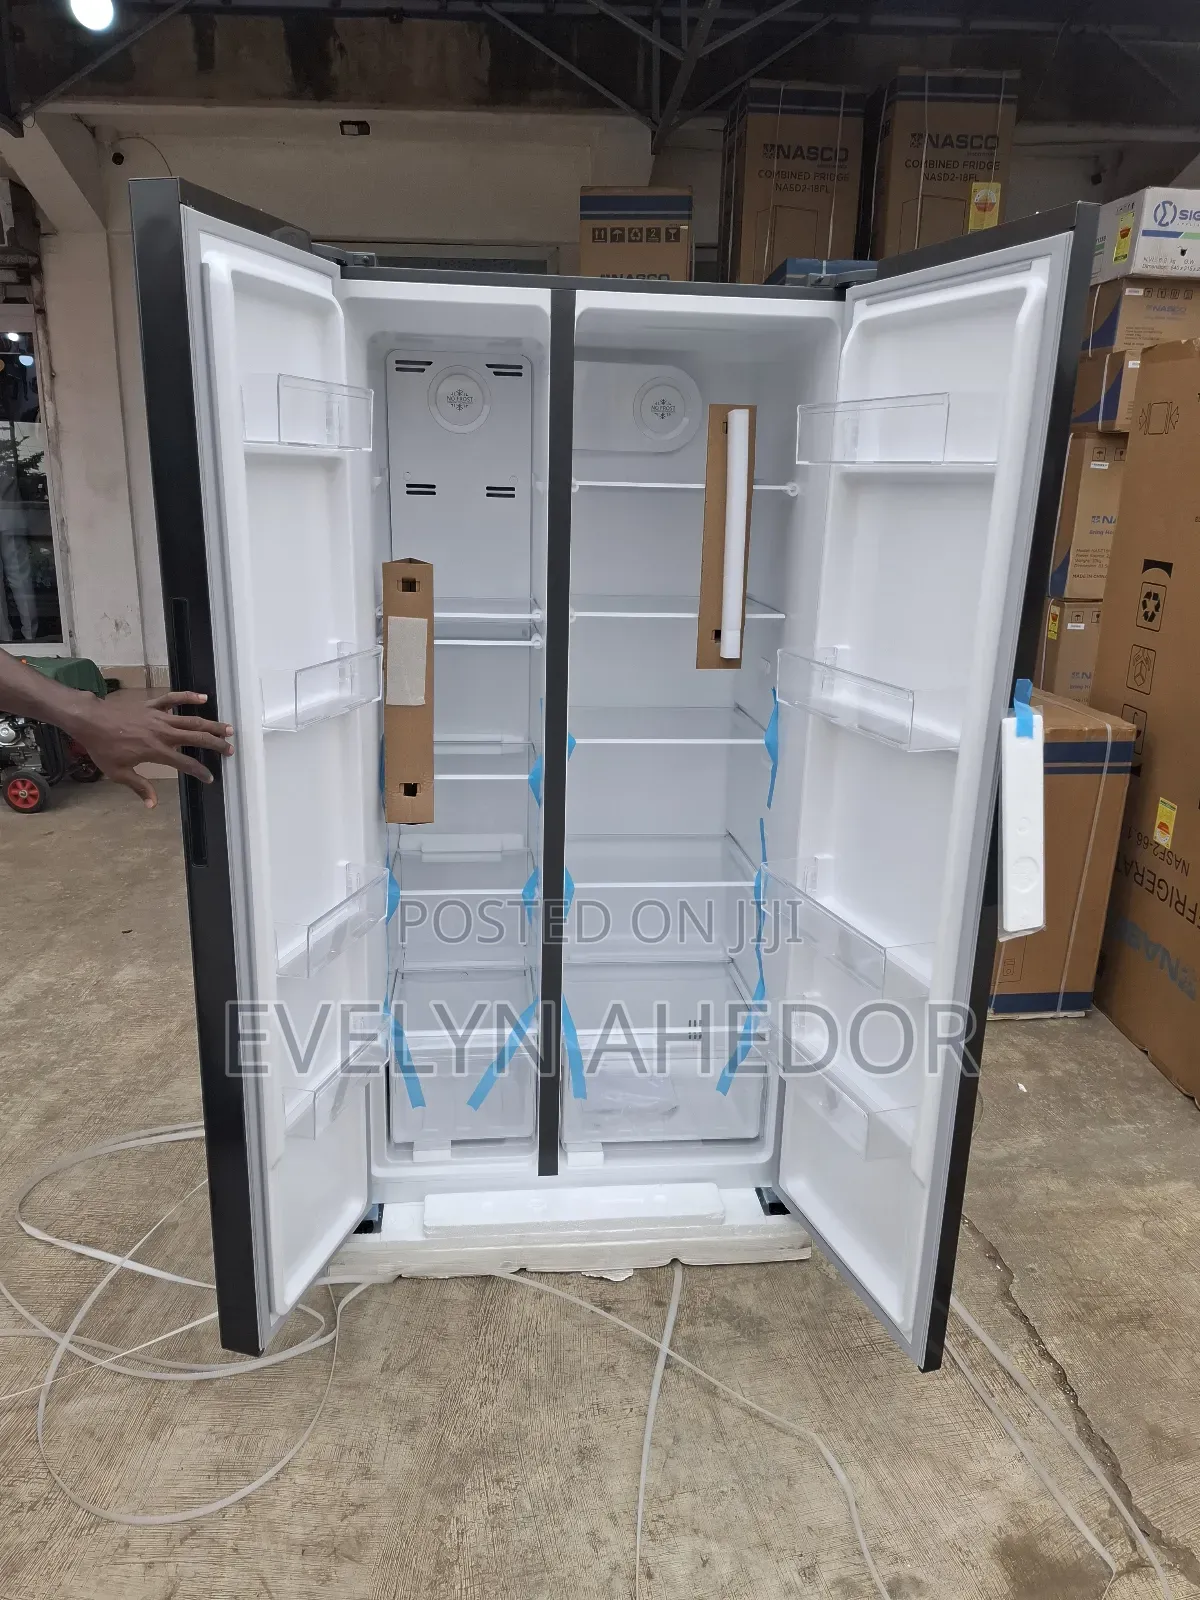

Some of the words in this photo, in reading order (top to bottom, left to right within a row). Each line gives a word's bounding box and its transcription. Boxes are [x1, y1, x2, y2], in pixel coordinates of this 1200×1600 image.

[926, 133, 999, 150] NASCO
[776, 144, 849, 162] NASCO
[904, 160, 960, 169] COMBINED
[962, 161, 1000, 171] FRIDGE
[758, 169, 811, 180] COMBINED
[814, 172, 850, 182] FRIDGE
[922, 172, 980, 183] NASD2-18FL
[775, 182, 831, 194] NASD2-18FL
